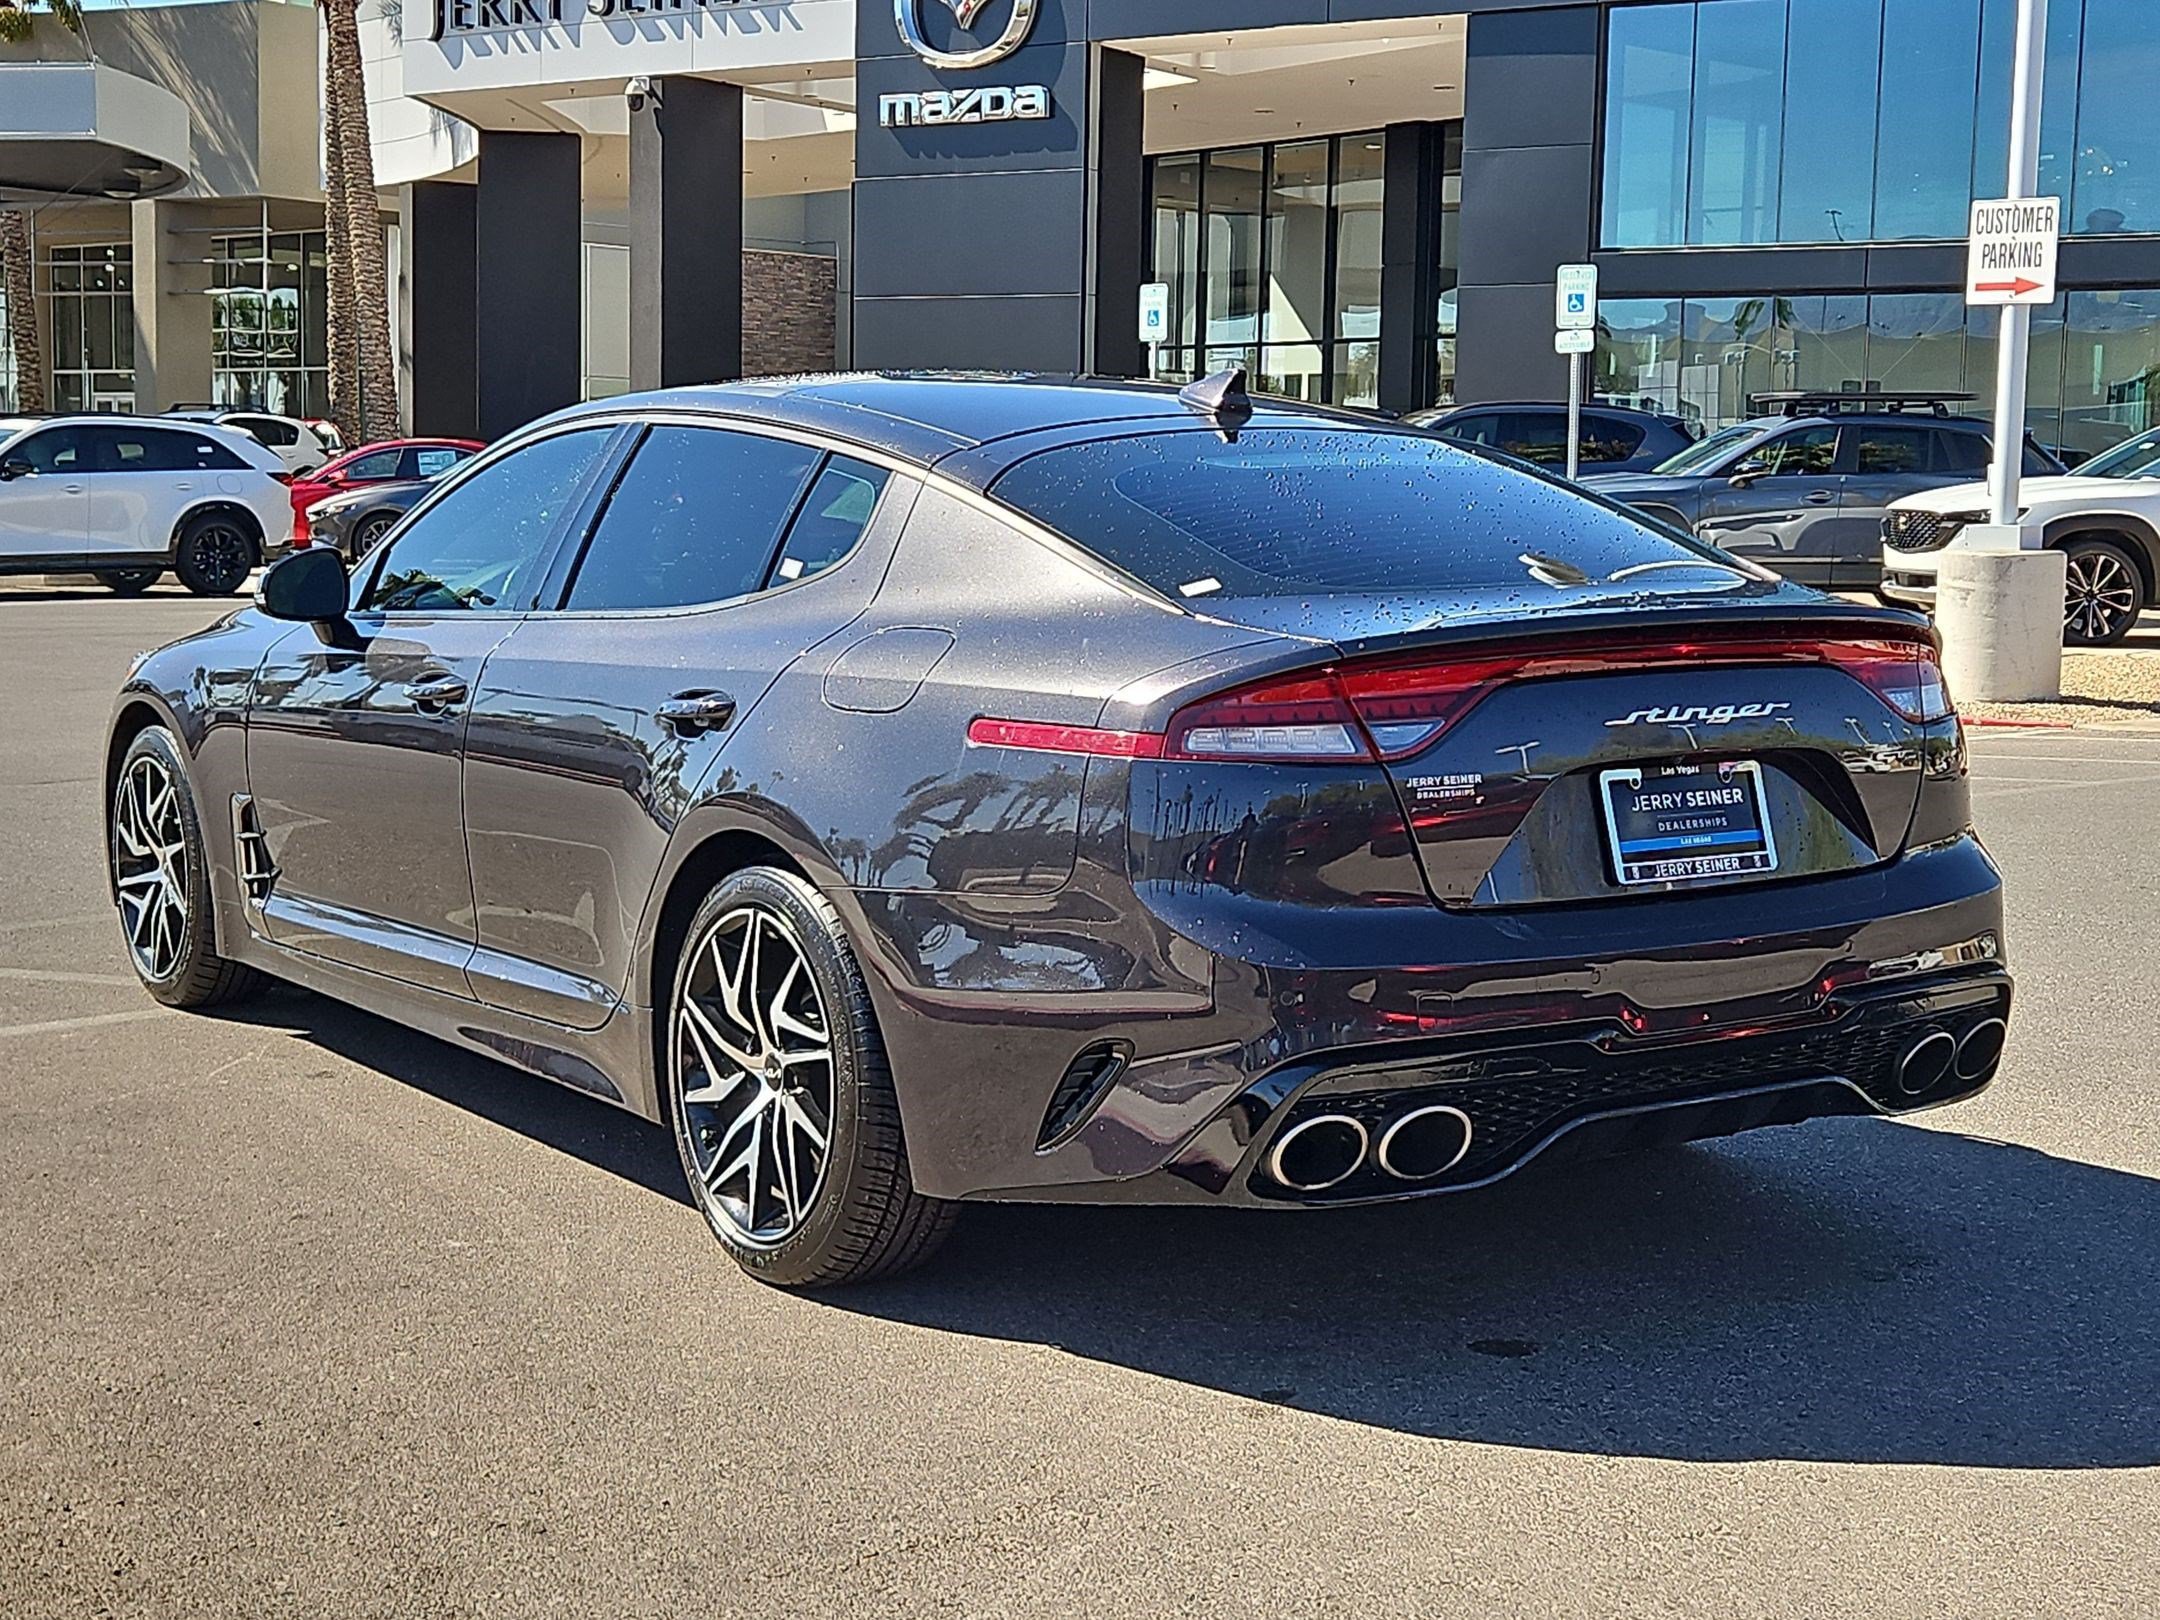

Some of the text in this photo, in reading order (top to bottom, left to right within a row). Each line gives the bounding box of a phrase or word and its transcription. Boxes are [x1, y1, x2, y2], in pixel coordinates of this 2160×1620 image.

[1976, 205, 2055, 235] CUSTOMER
[1981, 241, 2043, 269] PARKING
[1604, 703, 1791, 725] stinger
[1661, 764, 1700, 776] Las Vegas
[1406, 773, 1483, 788] JERRY SEINER
[1417, 788, 1476, 800] DEALERSHIPS
[1632, 788, 1743, 811] JERRY SEINER
[1658, 816, 1728, 832] DEALERSHIPS
[1654, 858, 1741, 878] JERRY SEINER
